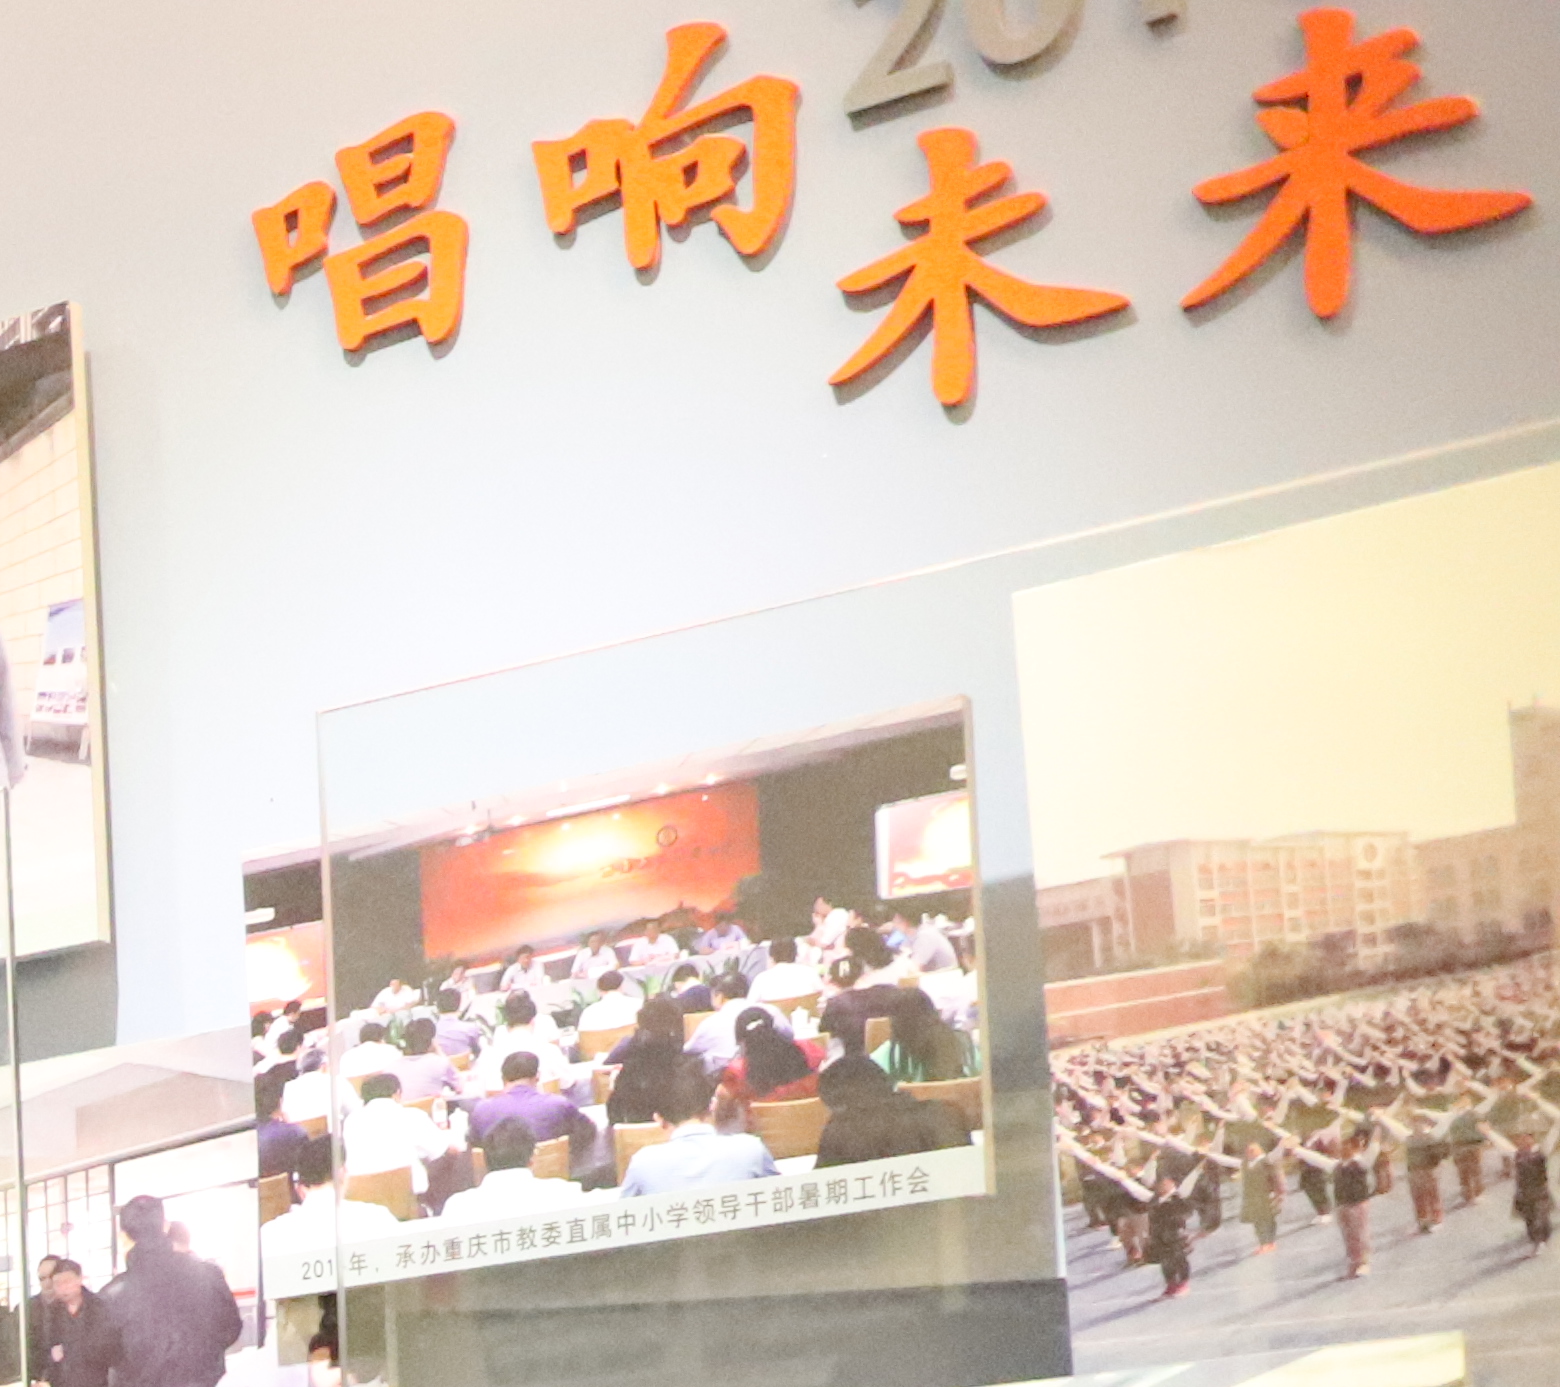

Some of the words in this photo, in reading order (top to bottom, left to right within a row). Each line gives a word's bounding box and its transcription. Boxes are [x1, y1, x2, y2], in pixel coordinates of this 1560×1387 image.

[252, 10, 1532, 406] 唱响未来
[301, 1166, 930, 1281] 201年，承办重庆市教委直属中小学领导干部暑期工作会
